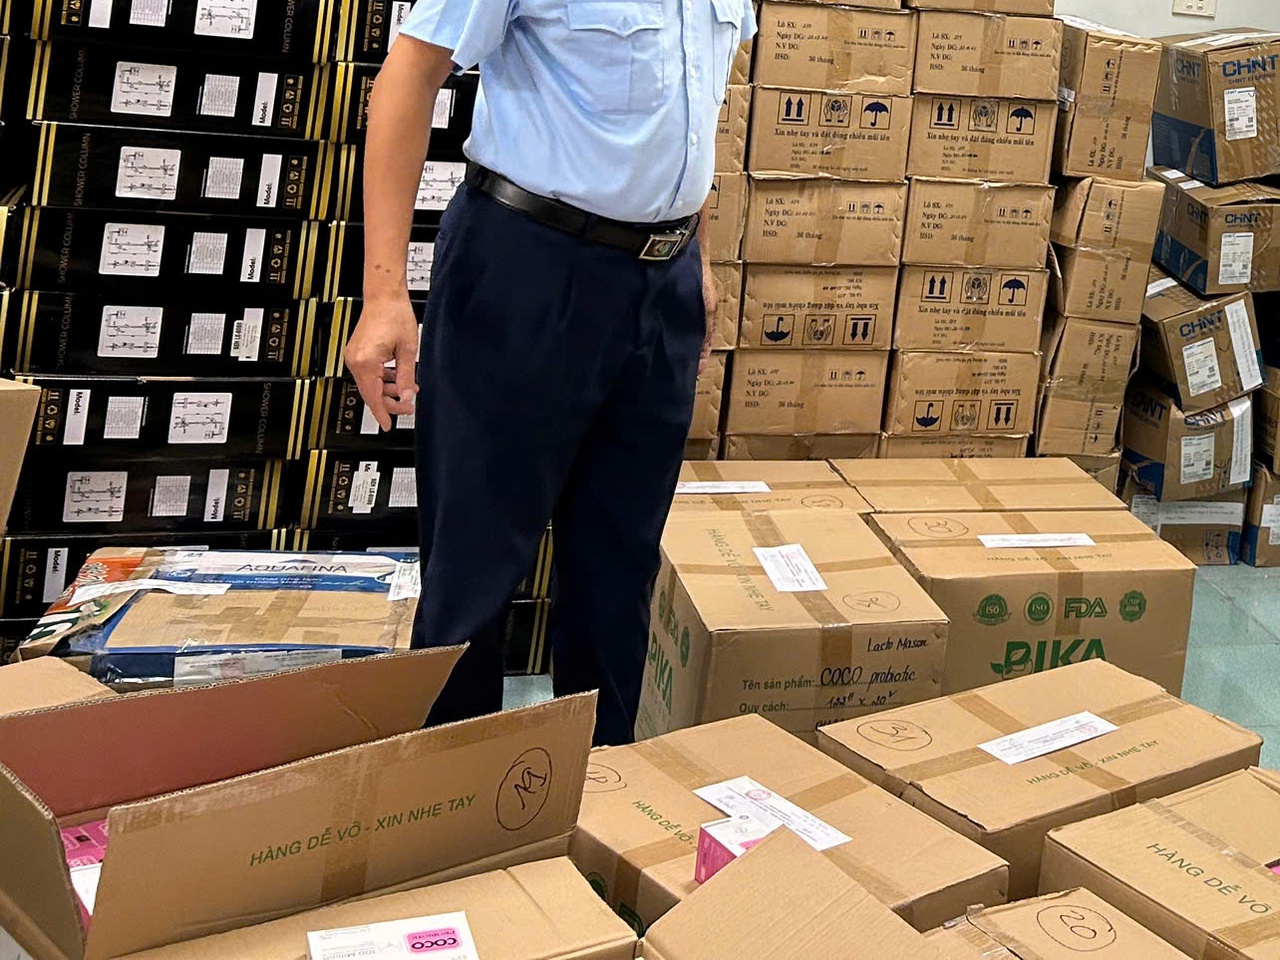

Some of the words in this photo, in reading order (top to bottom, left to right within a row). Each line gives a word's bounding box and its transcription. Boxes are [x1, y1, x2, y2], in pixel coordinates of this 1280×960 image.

[1222, 54, 1279, 77] CHNT
[259, 101, 268, 124] Model:
[264, 182, 272, 205] Model:
[1225, 213, 1261, 223] CHNT
[247, 257, 256, 280] Model:
[1180, 310, 1223, 338] CHNT
[74, 391, 83, 416] Model:
[211, 497, 220, 519] Model:
[236, 564, 348, 573] AQUAFINA
[985, 606, 999, 614] ISO
[1064, 598, 1108, 618] FDA
[1004, 639, 1108, 676] PIKA
[742, 679, 760, 690] Tên
[764, 677, 781, 689] sản
[784, 675, 814, 691] phẩm:
[821, 666, 863, 686] COCO
[739, 703, 759, 714] Quy
[763, 702, 789, 712] cách:
[1027, 771, 1060, 786] HÀNG
[1138, 739, 1159, 751] TAY
[632, 800, 660, 822] HÀNG
[662, 818, 680, 833] DỄ
[250, 841, 302, 867] HÀNG
[307, 827, 332, 850] DỄ
[337, 820, 362, 842] VỠ
[375, 812, 404, 831] XIN
[407, 803, 442, 823] NHẸ
[448, 794, 476, 812] TAY
[1146, 842, 1205, 878] HÀNG
[1204, 876, 1242, 897] DỄ
[1238, 897, 1272, 915] VỠ
[1060, 909, 1097, 939] 20
[411, 938, 457, 949] COCO
